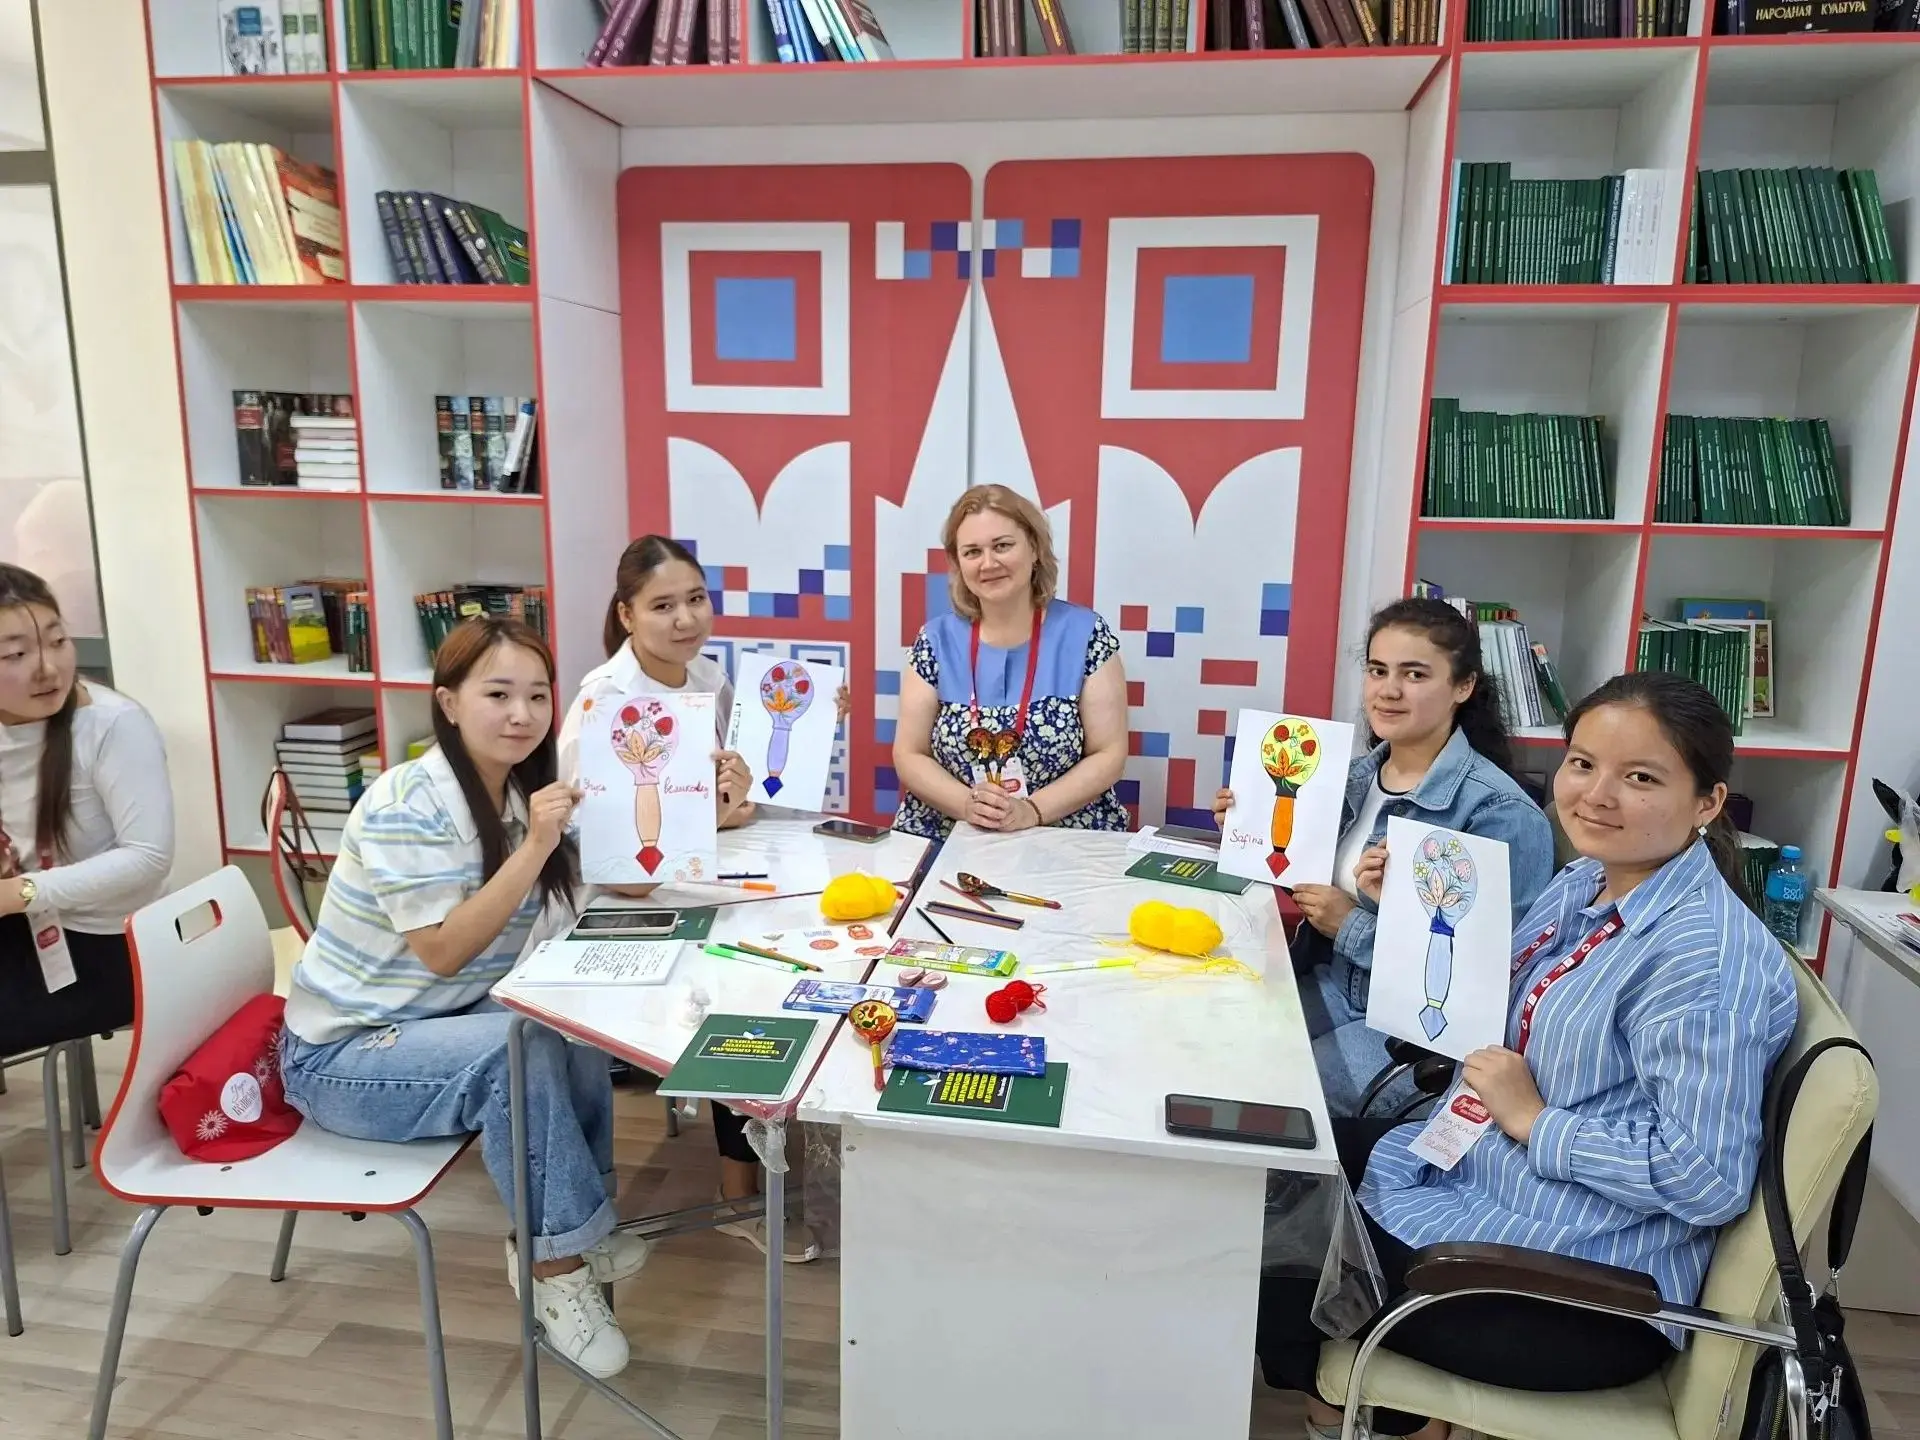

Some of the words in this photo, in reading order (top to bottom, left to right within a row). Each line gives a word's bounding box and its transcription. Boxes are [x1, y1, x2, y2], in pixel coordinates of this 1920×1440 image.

[1756, 5, 1812, 20] НАРОДНАЯ
[1821, 1, 1866, 15] КУЛЬТУРА
[1229, 828, 1264, 850] Safina
